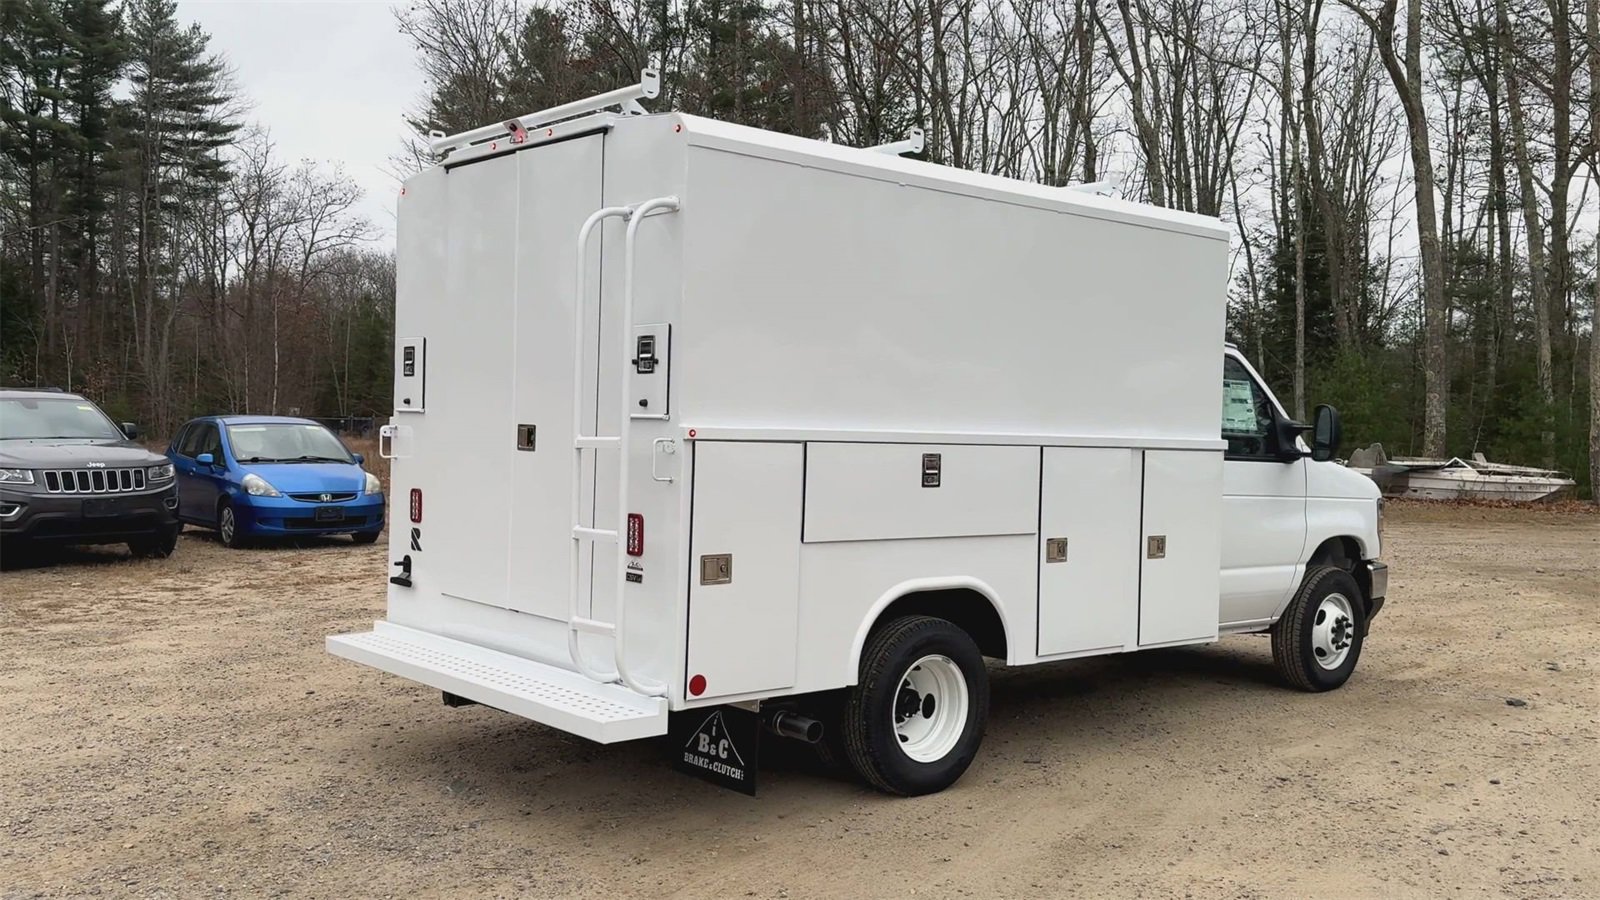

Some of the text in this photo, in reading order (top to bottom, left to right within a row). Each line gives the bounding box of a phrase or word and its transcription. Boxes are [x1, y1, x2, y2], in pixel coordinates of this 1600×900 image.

[697, 732, 729, 759] B&C
[683, 752, 709, 769] BRAKE
[713, 762, 741, 780] CLUTCH
